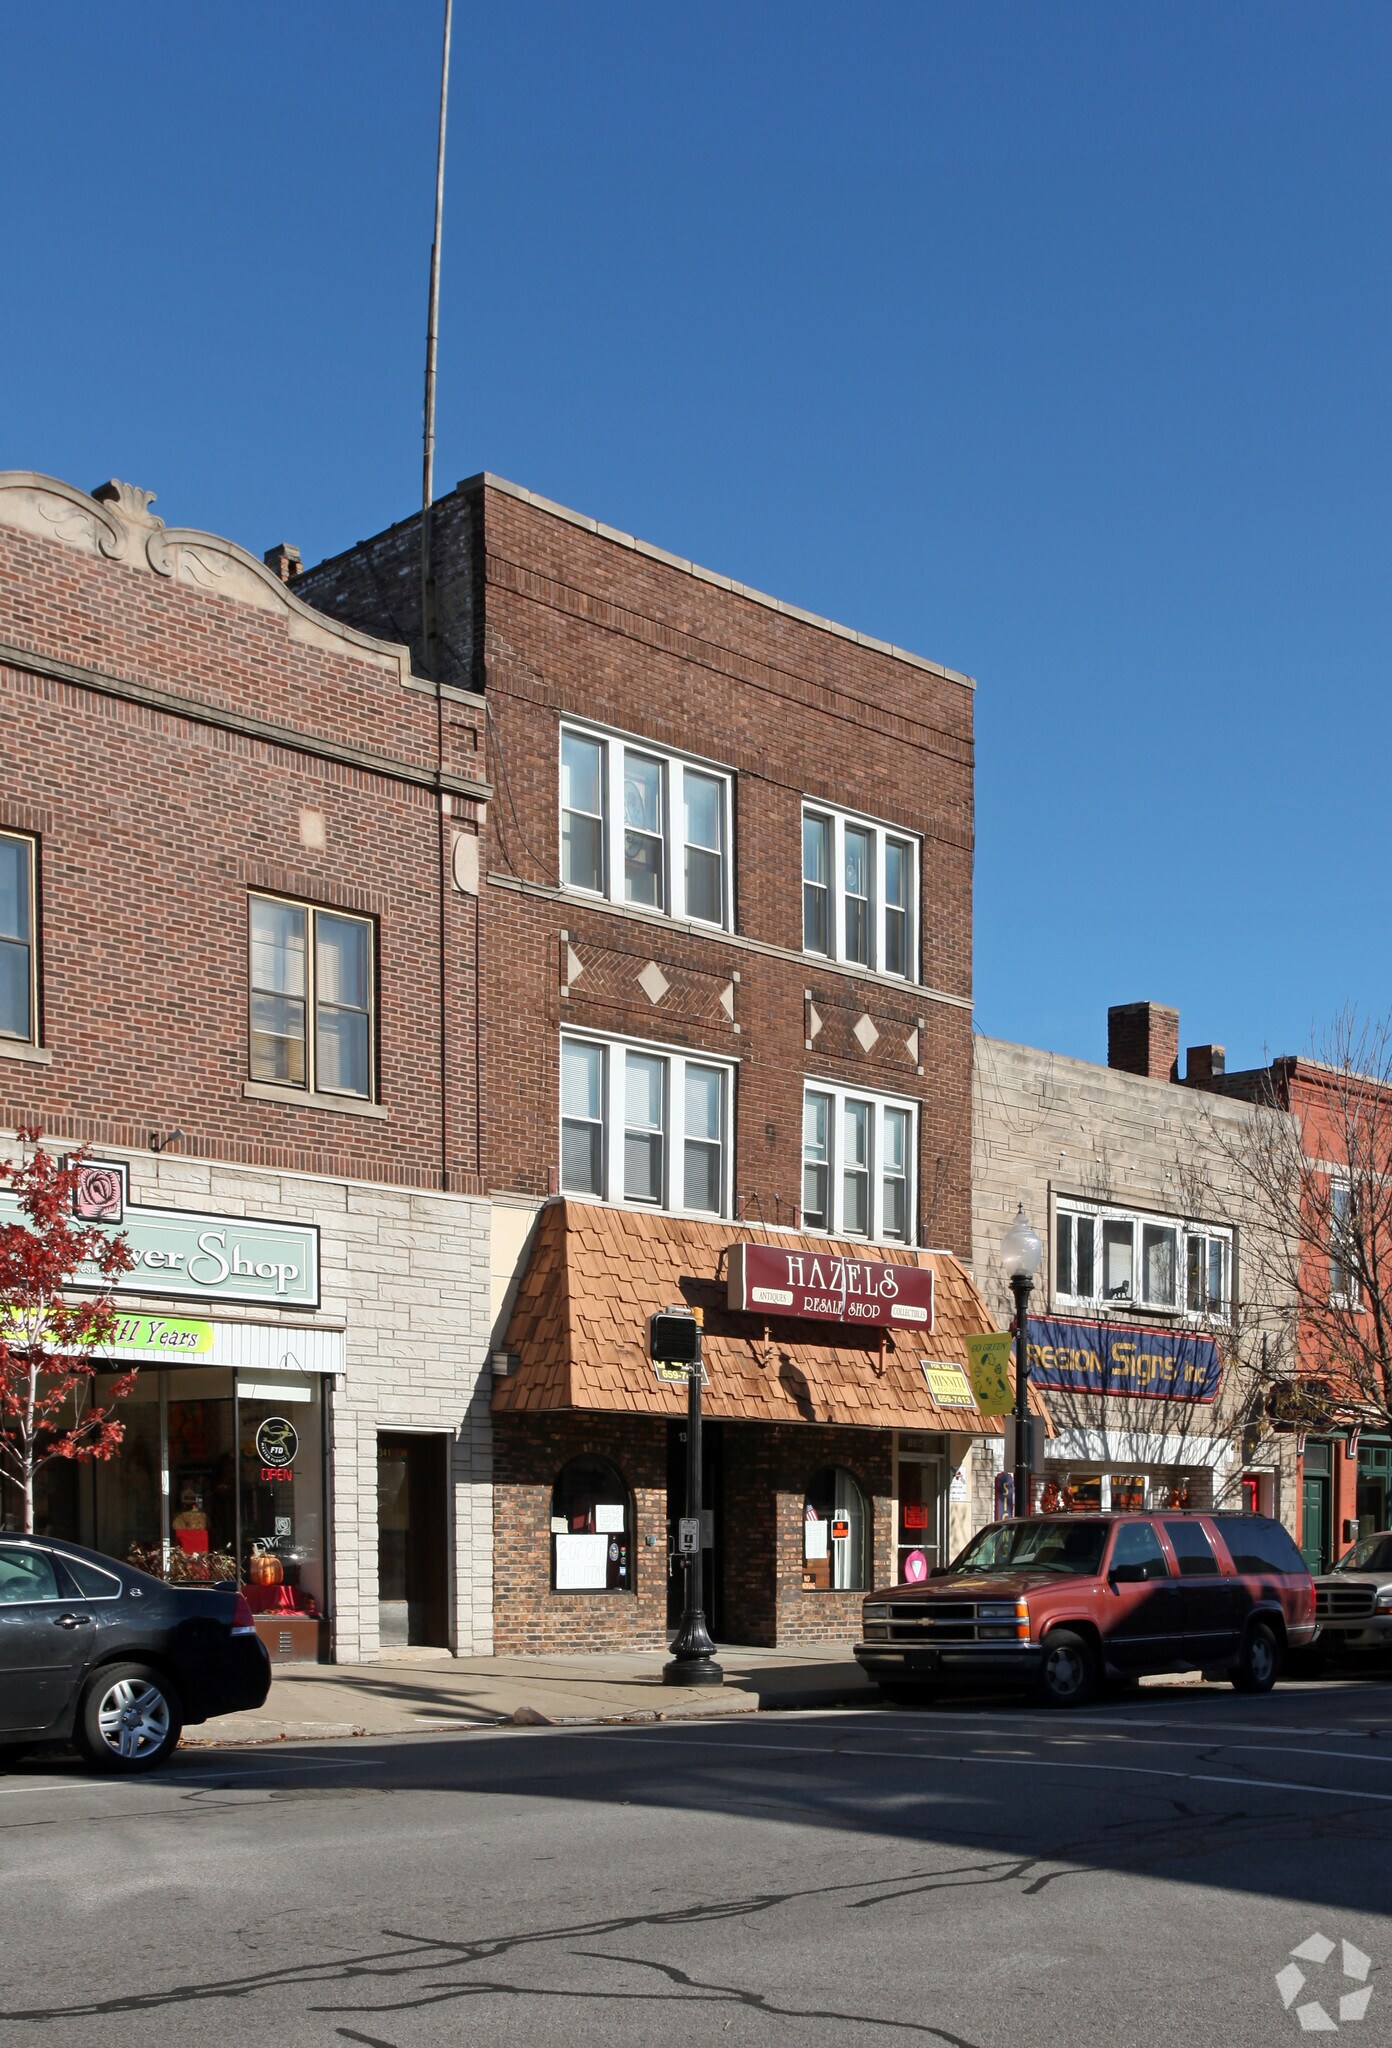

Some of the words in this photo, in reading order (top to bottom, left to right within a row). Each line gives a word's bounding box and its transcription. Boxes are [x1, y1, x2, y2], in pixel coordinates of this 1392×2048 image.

[187, 1229, 300, 1295] Shop
[785, 1255, 899, 1299] HAZELS
[758, 1292, 787, 1304] ANTIQUES
[803, 1296, 842, 1315] RESALE
[847, 1302, 880, 1319] SHOP
[892, 1305, 926, 1320] COLLECTIBLES
[146, 1321, 198, 1349] Years
[971, 1343, 982, 1353] GO
[982, 1342, 1008, 1352] GREEN
[1026, 1343, 1103, 1375] REGION
[1111, 1342, 1177, 1386] Signs
[937, 1394, 972, 1404] 659-7413
[270, 1446, 284, 1454] FTD
[260, 1468, 293, 1482] OPEN
